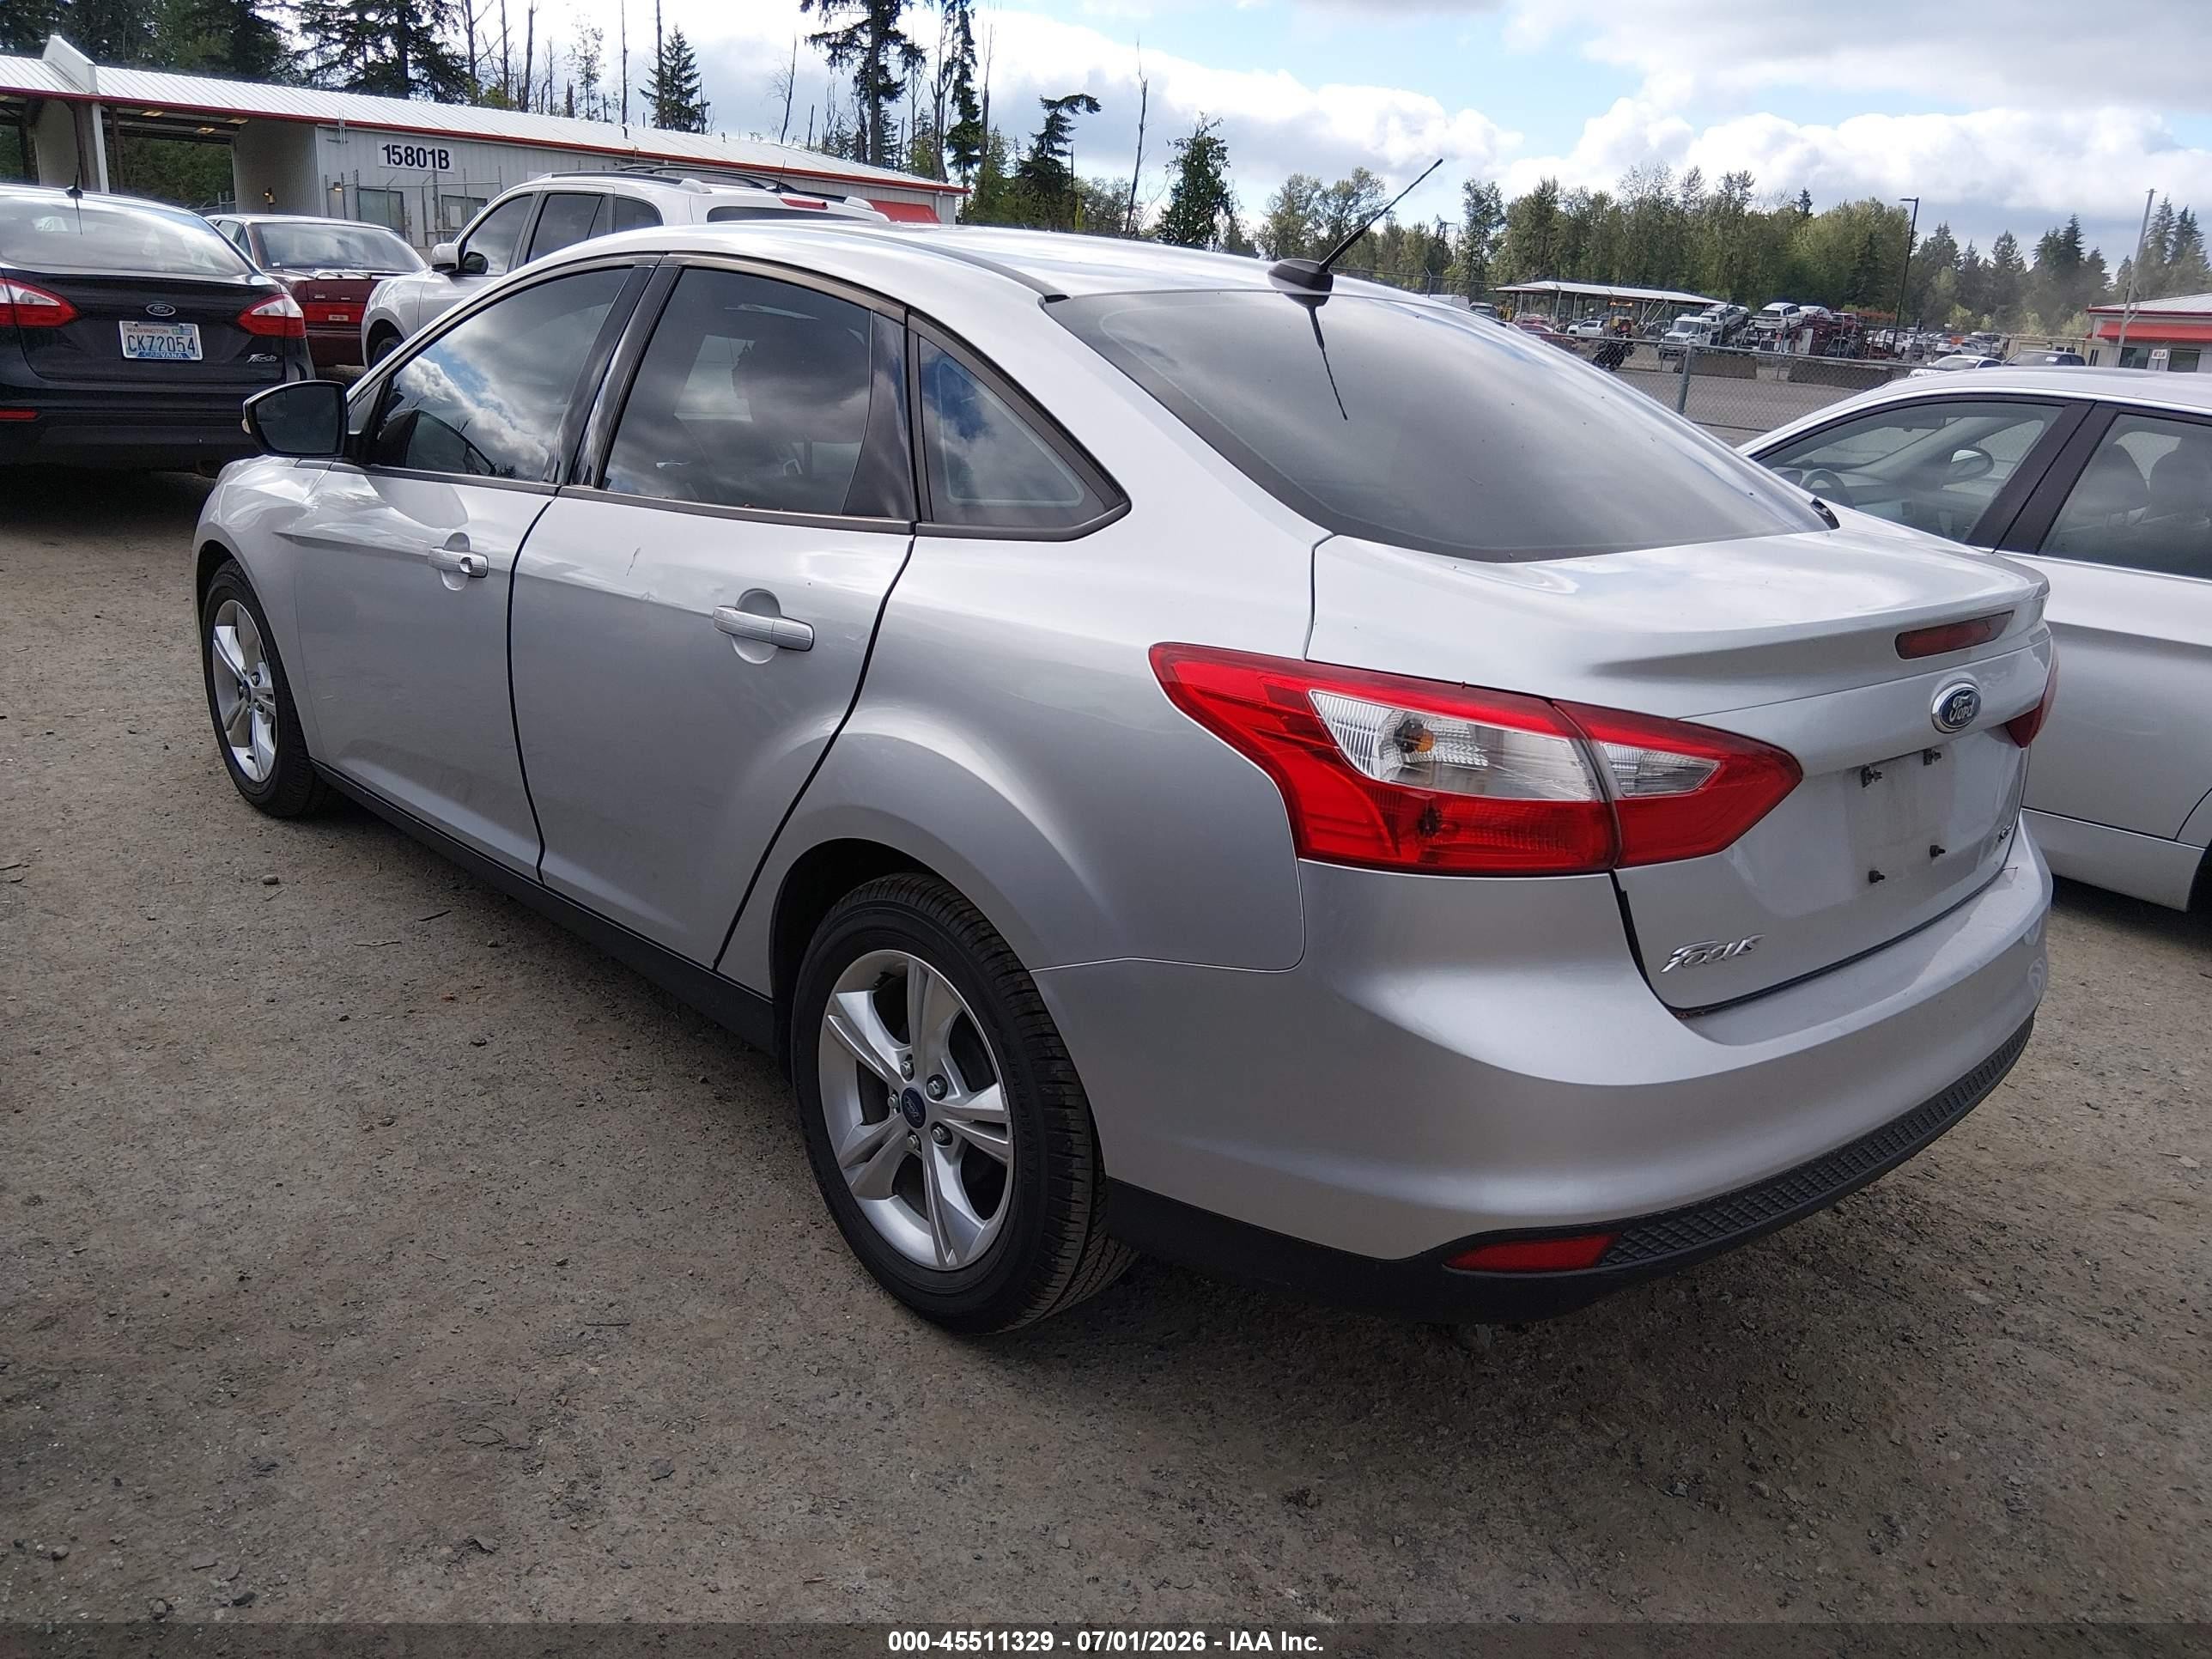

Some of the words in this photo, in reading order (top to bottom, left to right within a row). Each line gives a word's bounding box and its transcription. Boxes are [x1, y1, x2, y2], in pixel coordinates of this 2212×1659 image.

[382, 143, 450, 170] 15801B
[1949, 692, 1976, 723] Ford
[1660, 933, 1765, 973] Focus
